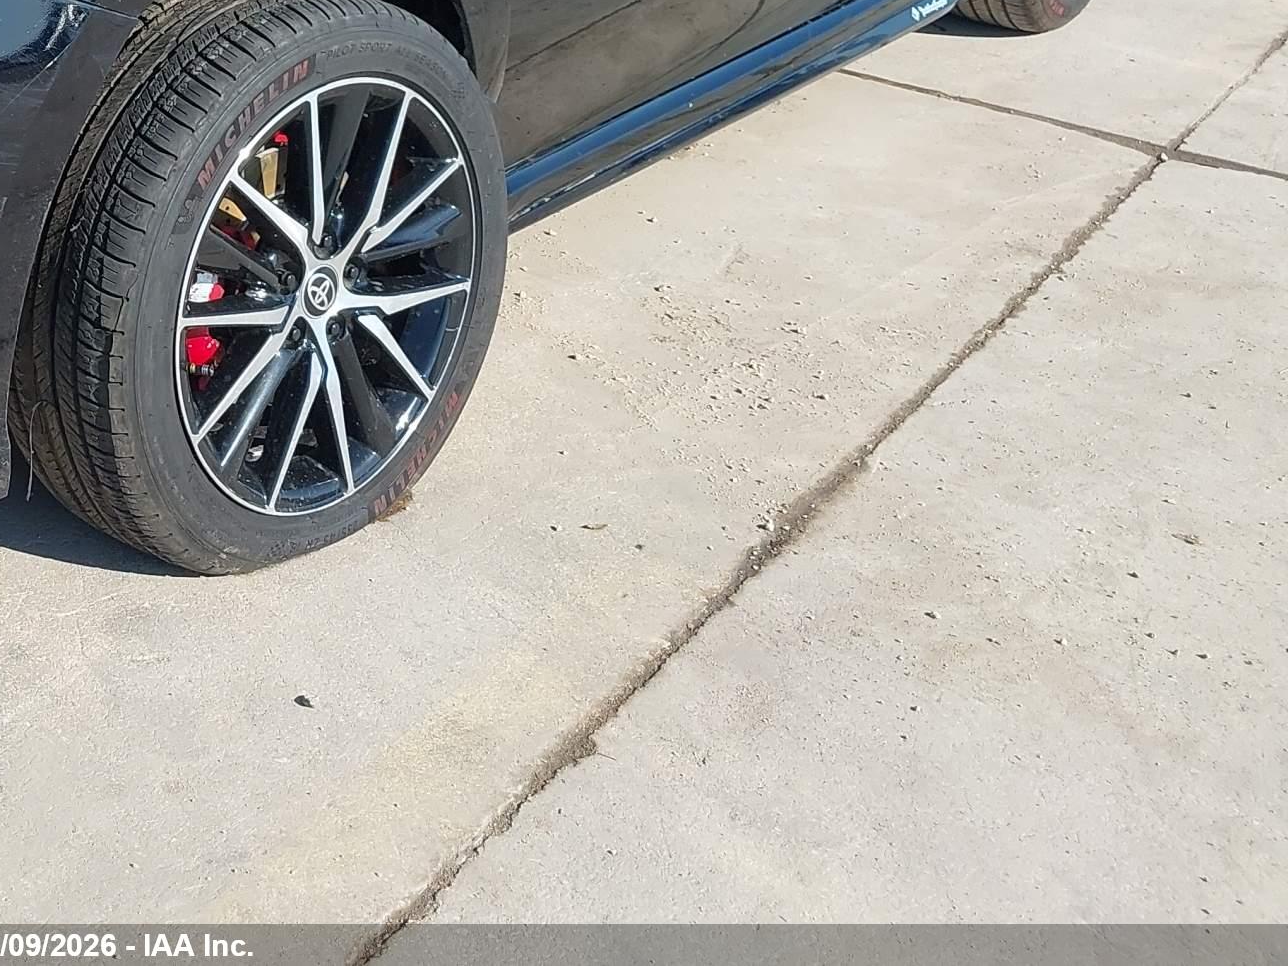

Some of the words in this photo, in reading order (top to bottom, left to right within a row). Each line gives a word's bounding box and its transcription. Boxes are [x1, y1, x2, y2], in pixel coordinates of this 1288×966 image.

[358, 42, 393, 54] SPORT
[197, 57, 310, 190] MICHELIN
[373, 392, 460, 517] MICHELIN
